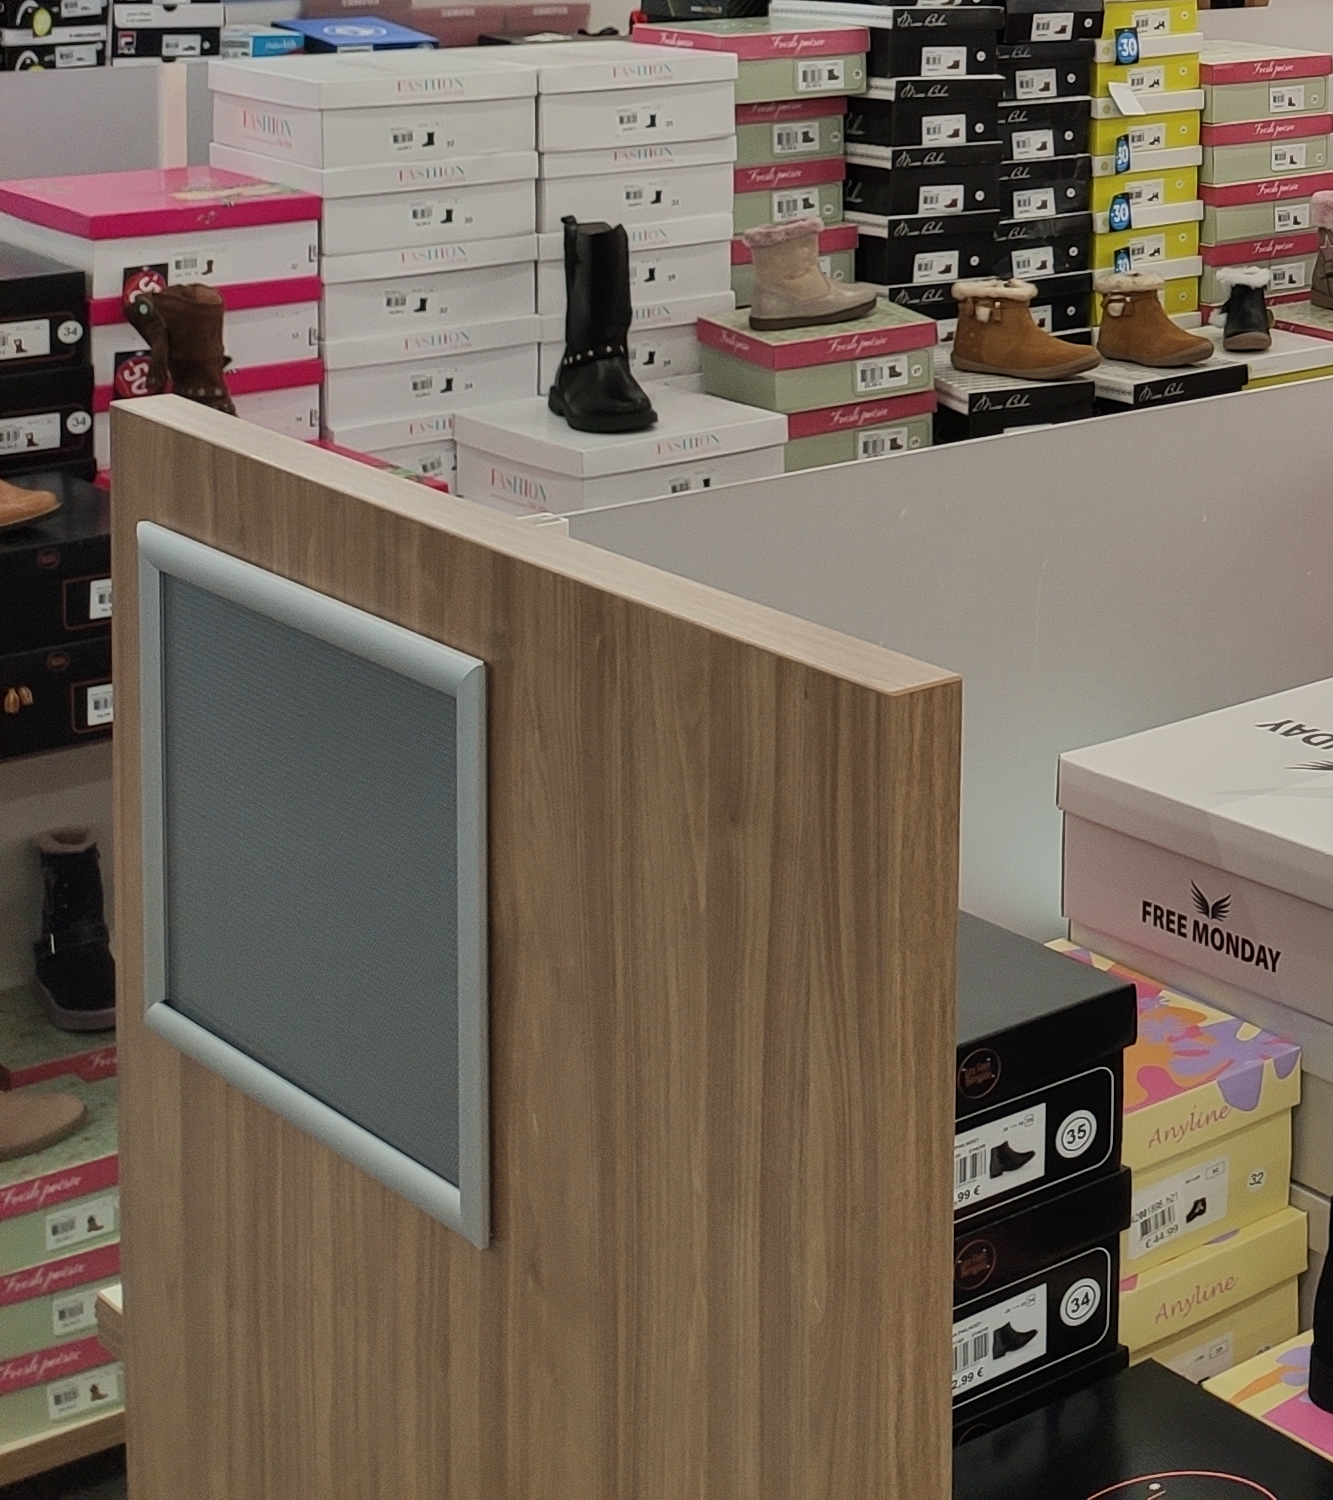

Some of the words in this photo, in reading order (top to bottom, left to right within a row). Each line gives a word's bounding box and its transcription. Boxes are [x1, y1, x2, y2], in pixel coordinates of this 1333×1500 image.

[397, 77, 464, 93] FASHION
[1140, 900, 1189, 944] FREE
[1192, 919, 1282, 974] MONDAY
[1066, 1123, 1087, 1145] 35
[1149, 1105, 1232, 1148] Anyline
[1249, 1172, 1264, 1186] 32
[1153, 1224, 1179, 1244] 44.99
[1070, 1291, 1090, 1314] 34
[1155, 1275, 1238, 1325] Anyline
